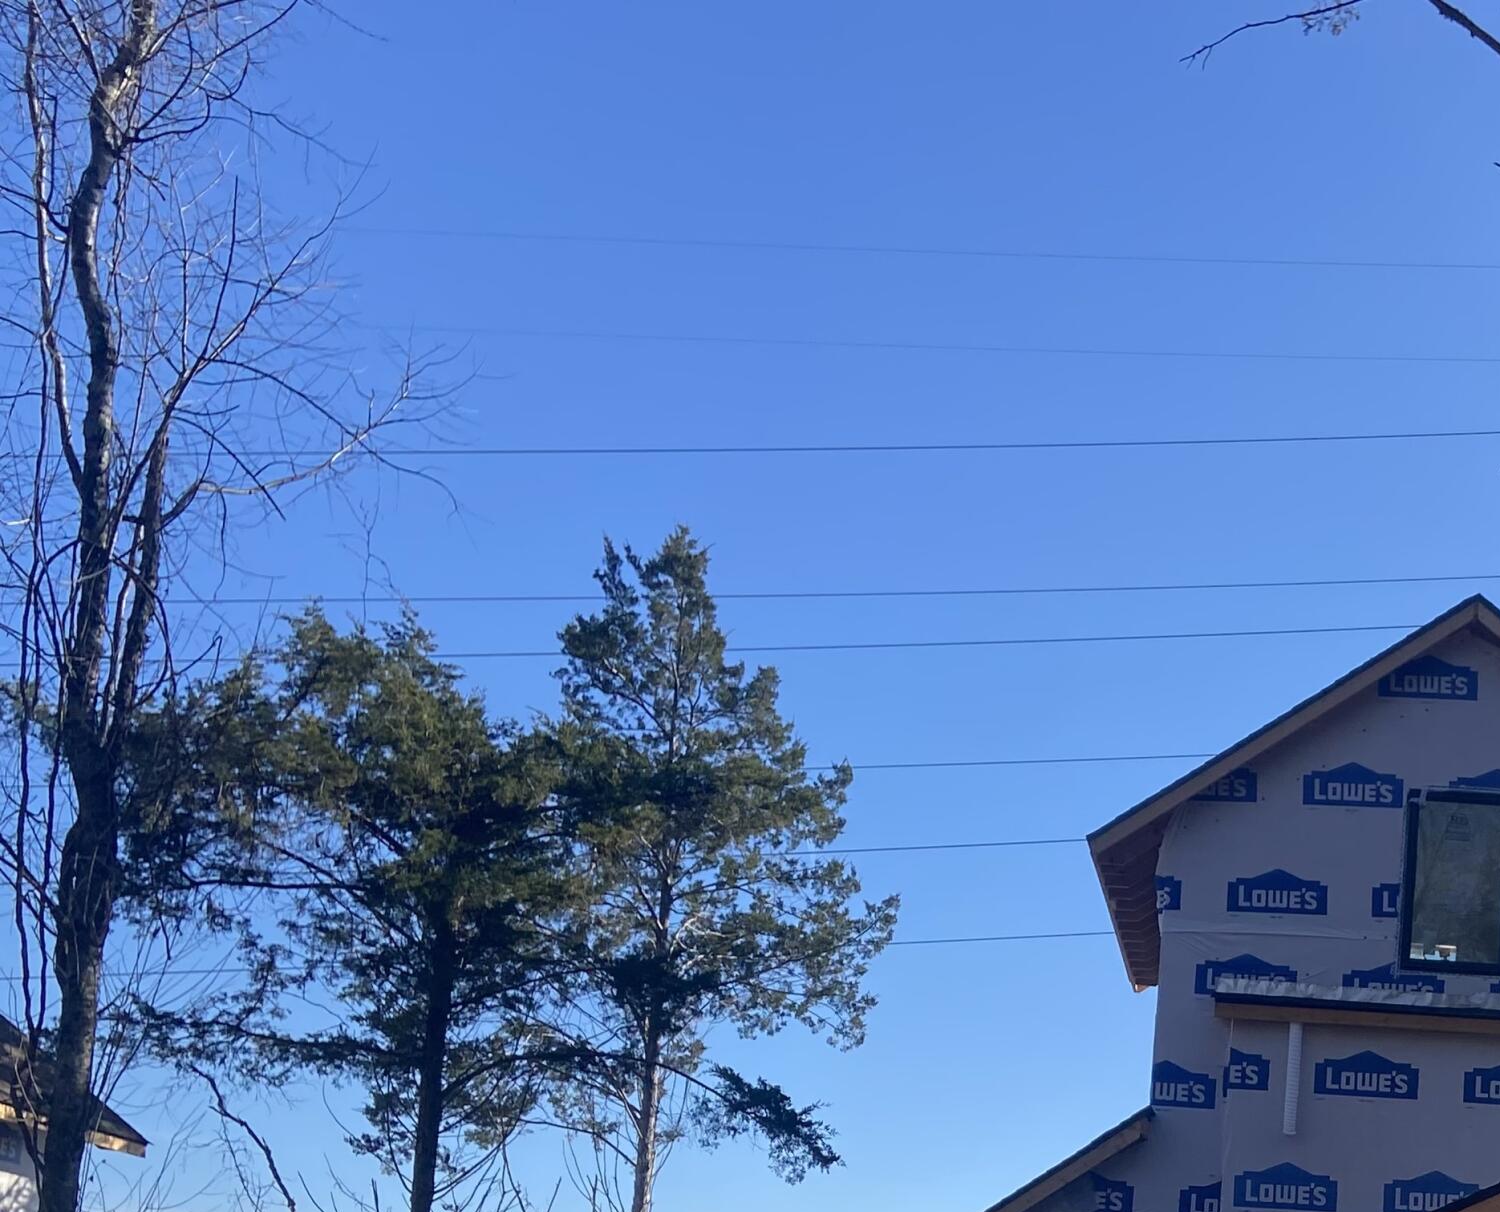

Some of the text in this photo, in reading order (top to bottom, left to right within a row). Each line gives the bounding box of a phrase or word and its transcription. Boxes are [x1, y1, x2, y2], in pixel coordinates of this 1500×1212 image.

[1388, 673, 1469, 696] LOWE'S
[1313, 779, 1394, 804] LOWE'S
[1238, 885, 1318, 910] LOWE'S
[1229, 1061, 1259, 1085] E'S
[1326, 1066, 1409, 1095] LOWE'S
[1154, 1080, 1206, 1104] WE'S
[1096, 1188, 1123, 1212] E'S
[1245, 1179, 1327, 1206] LOWE'S
